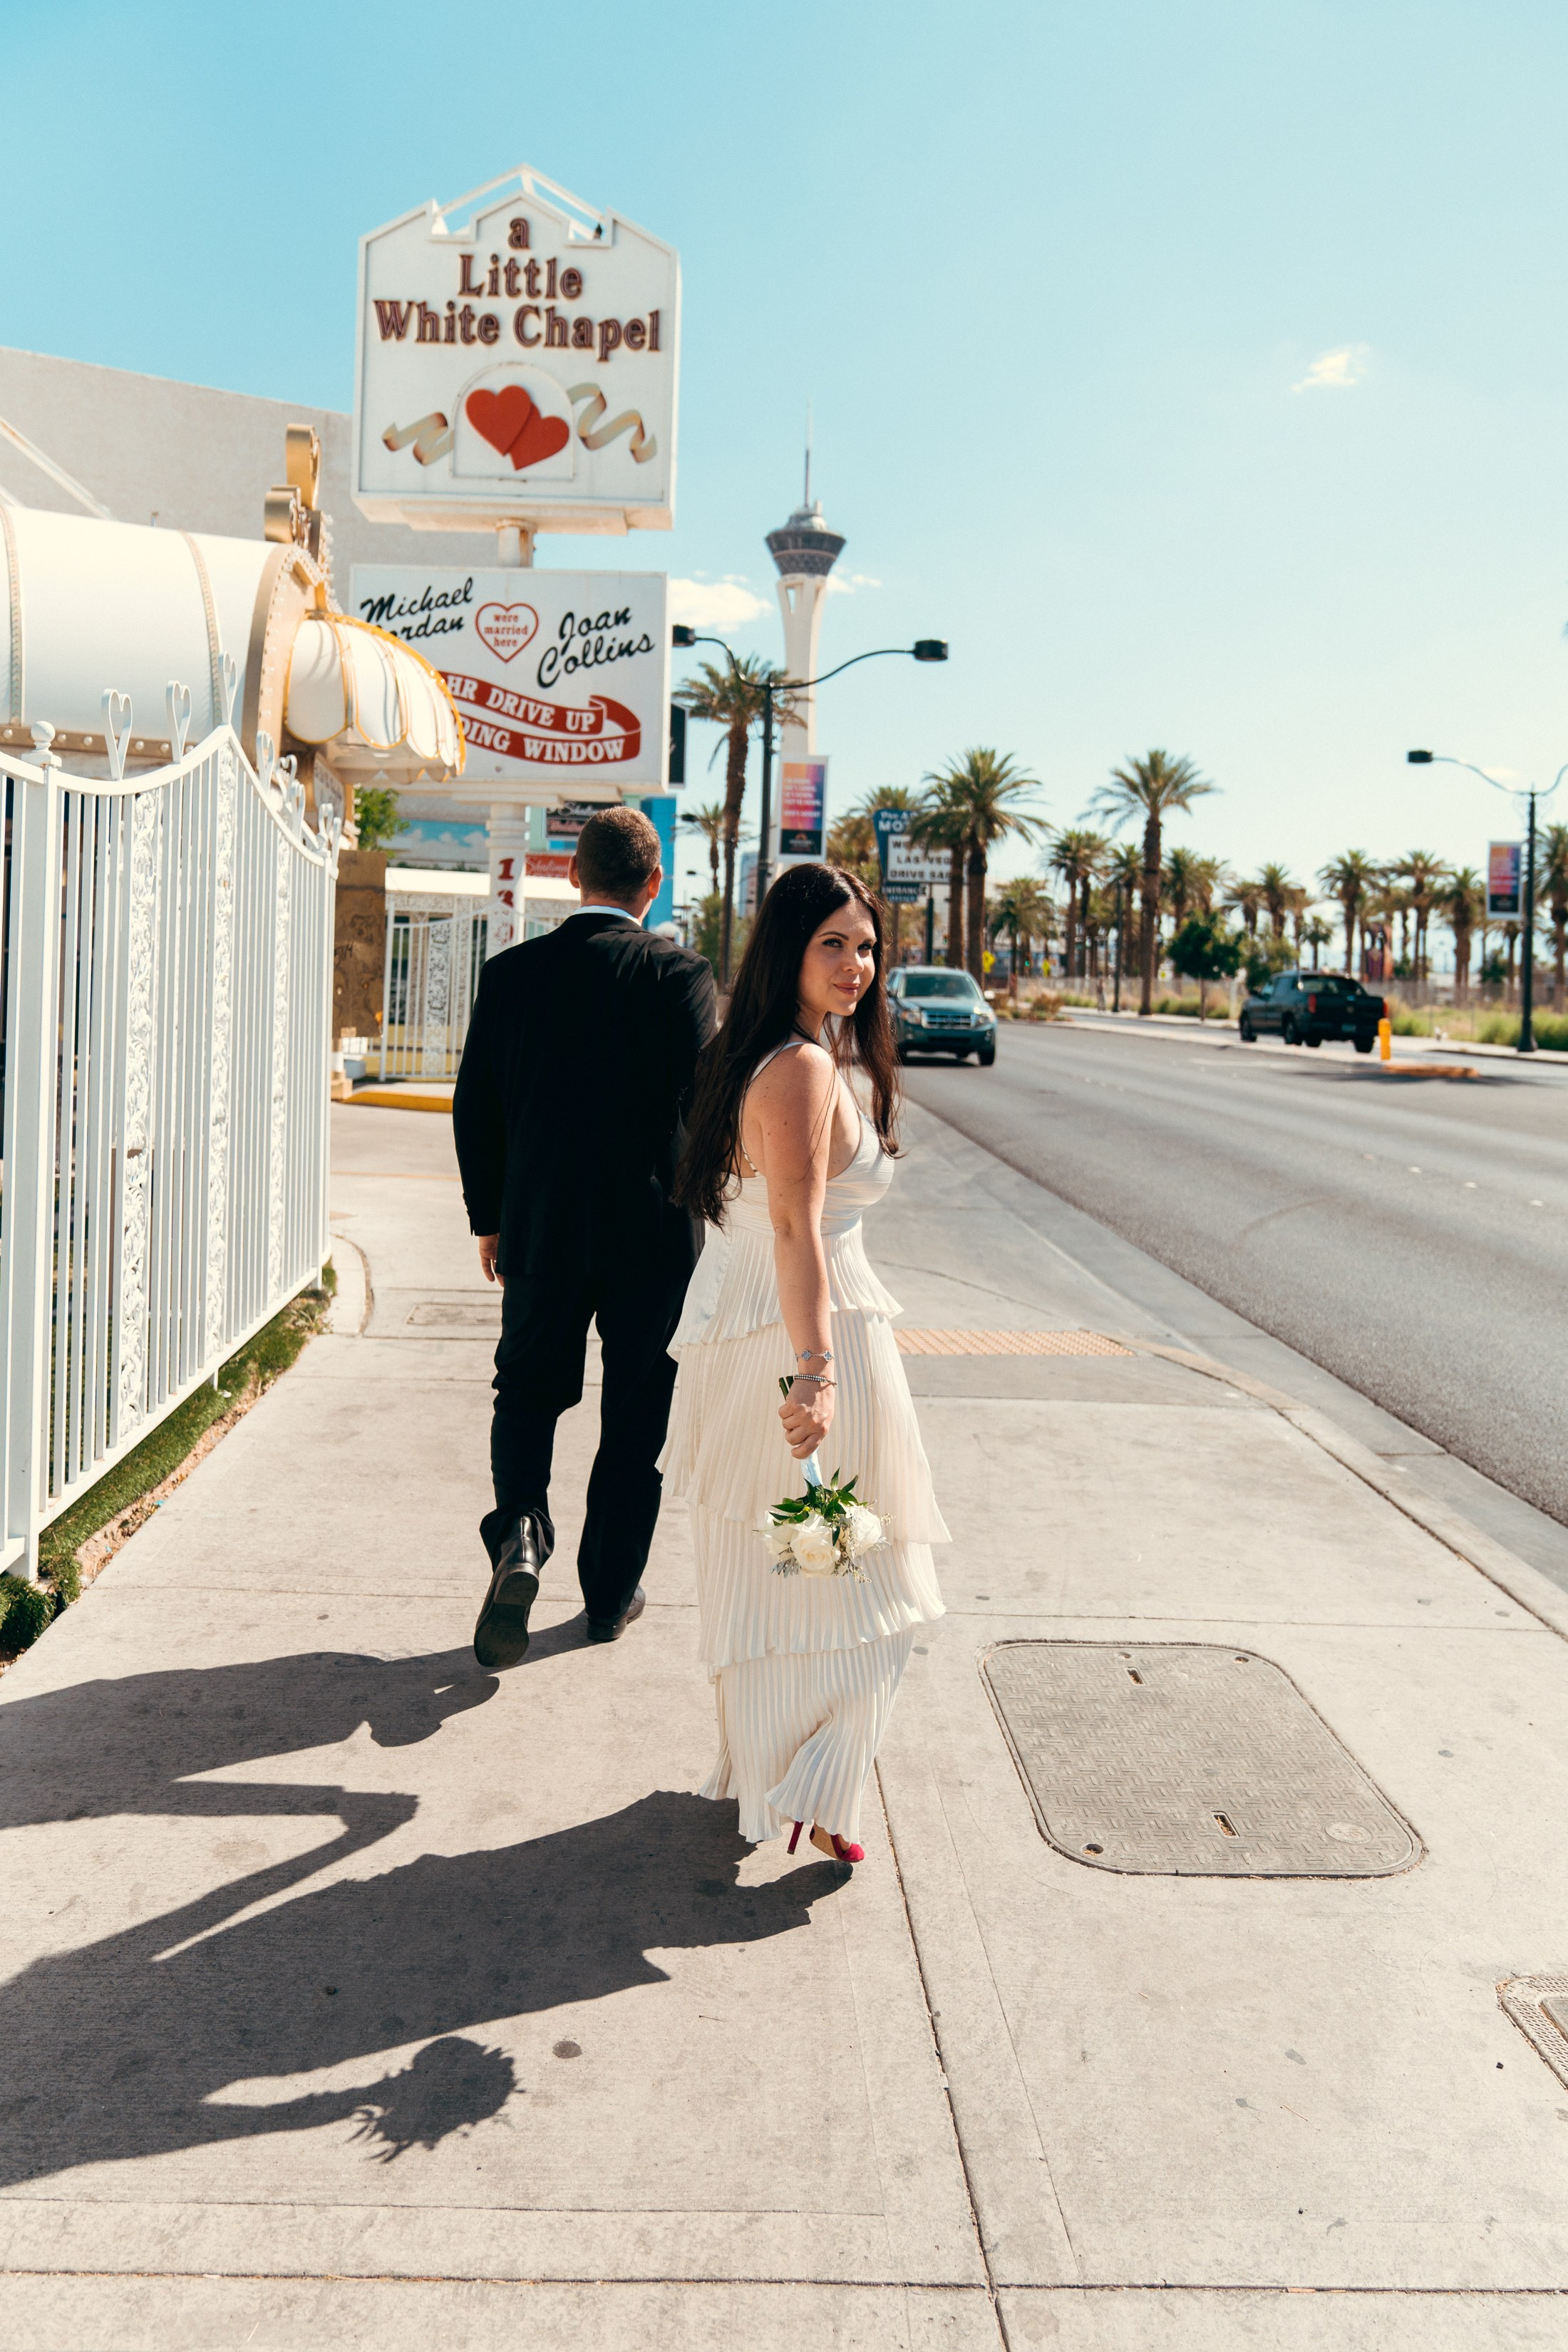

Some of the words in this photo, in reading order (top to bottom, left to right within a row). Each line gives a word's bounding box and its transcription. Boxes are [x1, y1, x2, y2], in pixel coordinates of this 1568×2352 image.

[507, 217, 530, 249] a
[458, 253, 584, 300] Little
[373, 299, 500, 346] White
[512, 304, 661, 362] Chapel
[360, 576, 473, 623] Michael
[493, 614, 519, 623] were
[484, 625, 529, 635] married
[493, 637, 518, 648] here
[559, 606, 632, 656] Joan
[537, 633, 655, 689] Collins
[446, 675, 478, 701] HR
[485, 687, 555, 726] DRIVE
[565, 711, 596, 733] UP
[461, 716, 511, 752] DING
[523, 737, 625, 763] WINDOW
[928, 856, 954, 865] VEG
